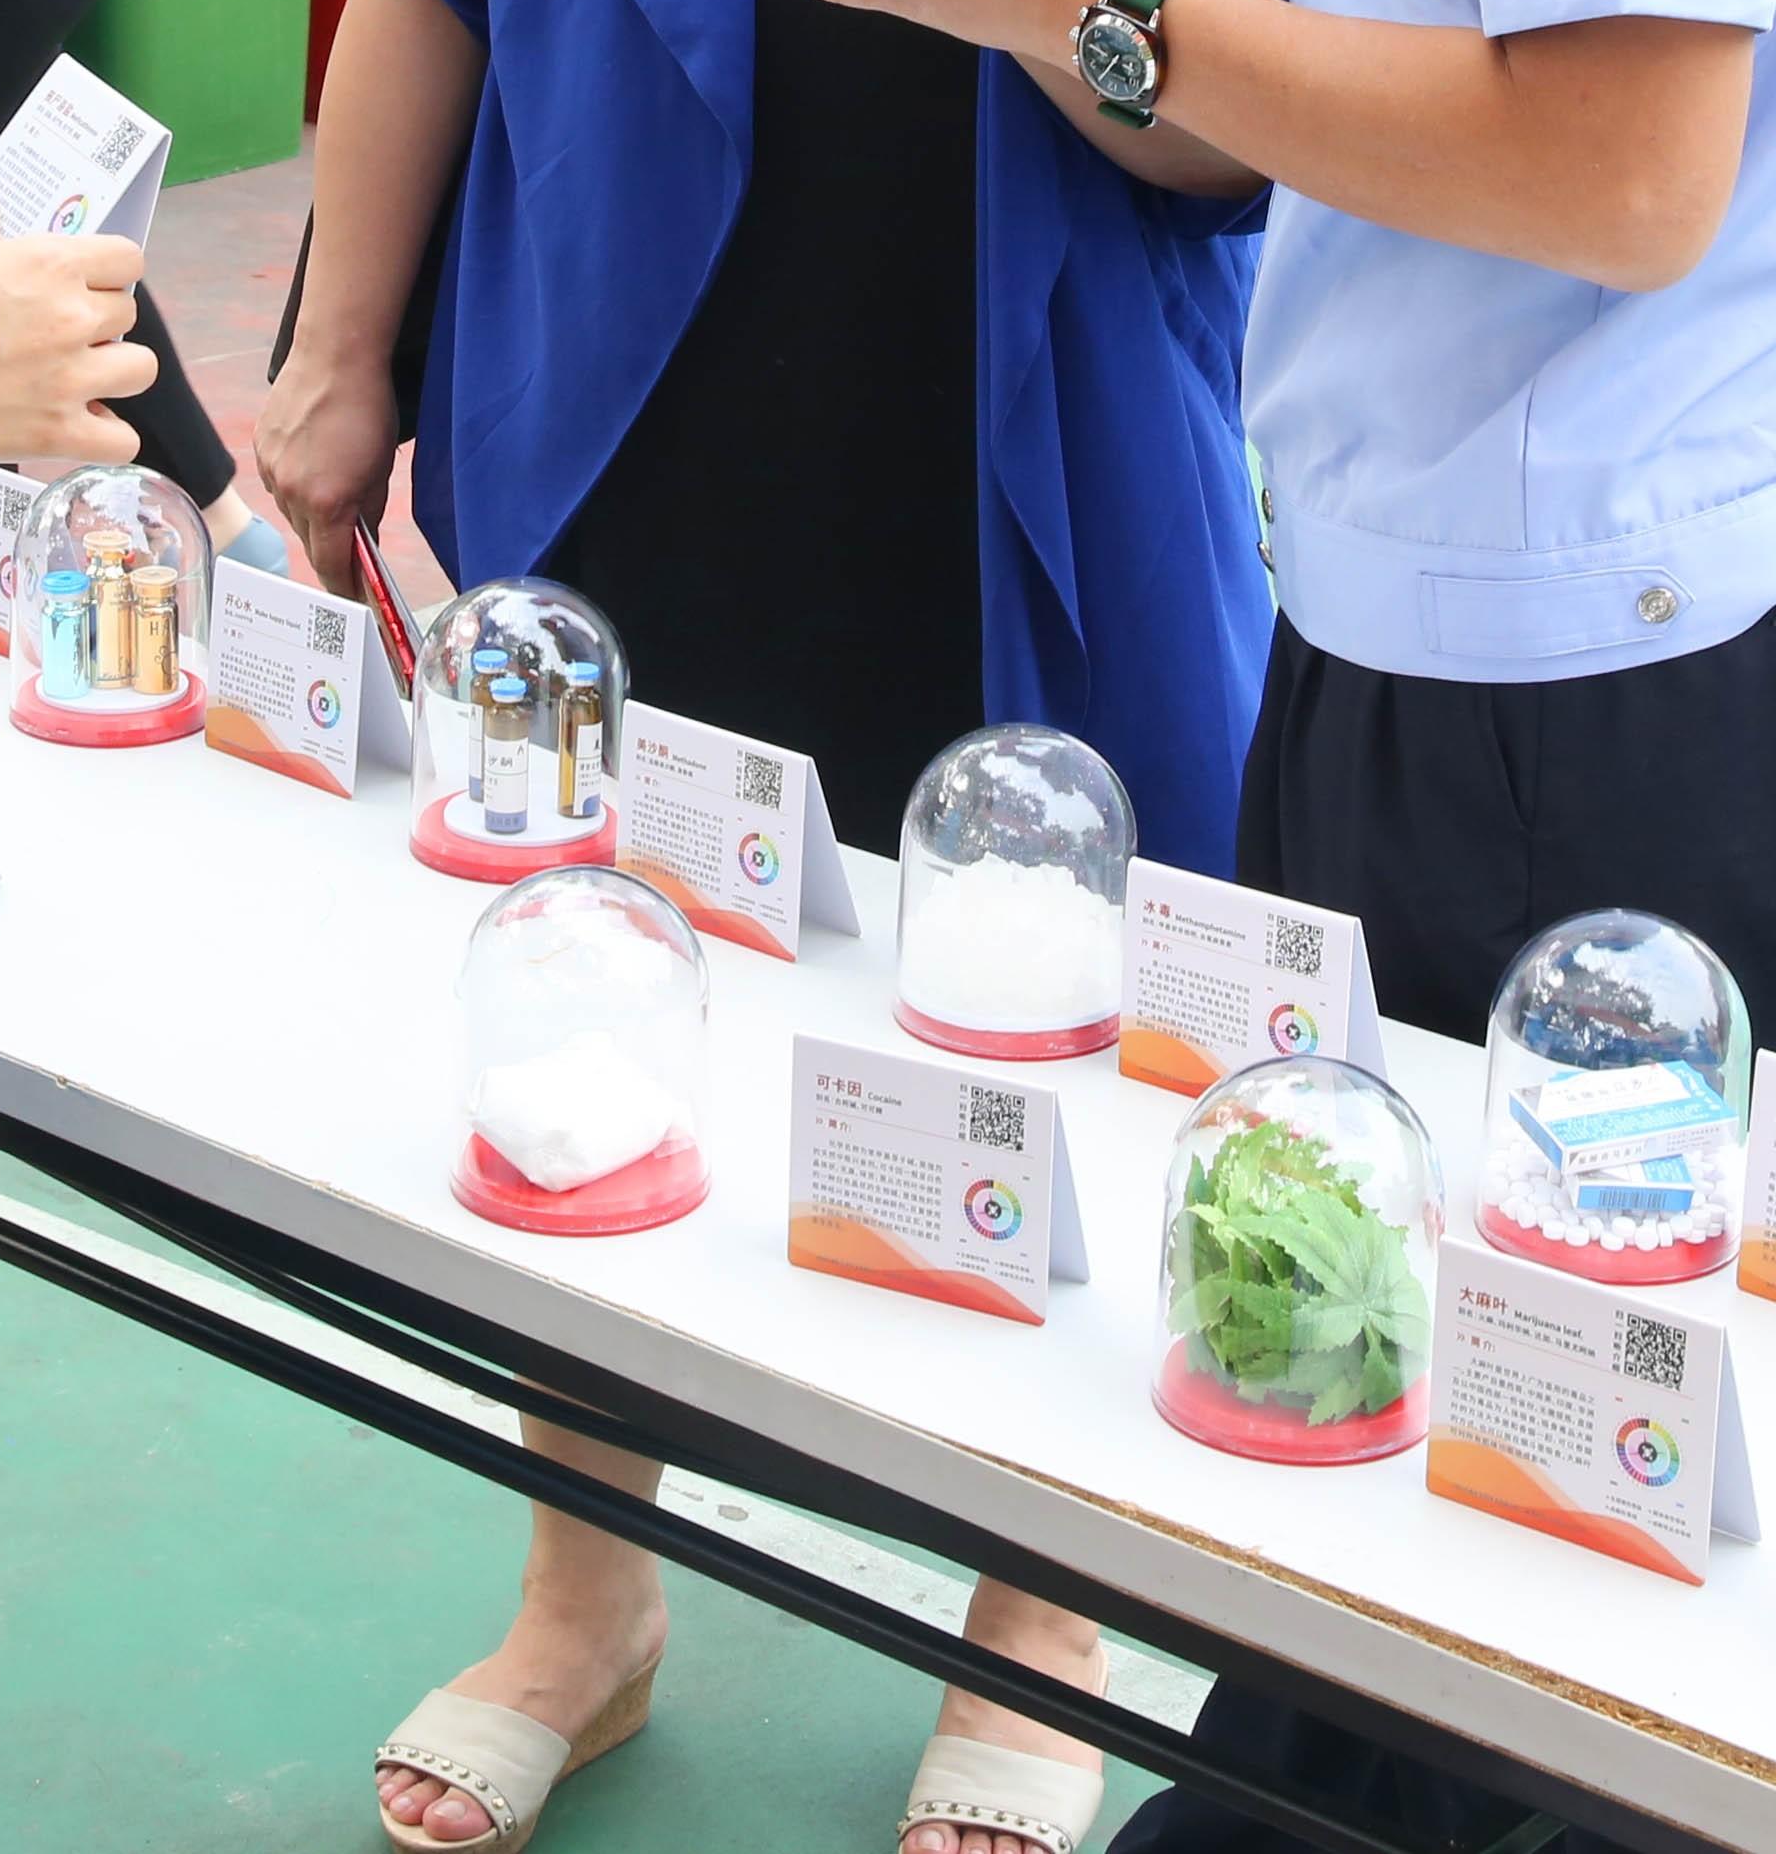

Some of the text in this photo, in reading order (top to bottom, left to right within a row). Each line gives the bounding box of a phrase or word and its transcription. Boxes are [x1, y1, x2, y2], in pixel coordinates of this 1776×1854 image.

[225, 593, 253, 612] 开心水
[636, 737, 670, 760] 美沙酮
[1143, 896, 1170, 919] 冰毒
[816, 1071, 902, 1108] 可卡因 Cocaine
[1459, 1284, 1508, 1316] 大麻叶
[1513, 1308, 1561, 1334] Marijuana
